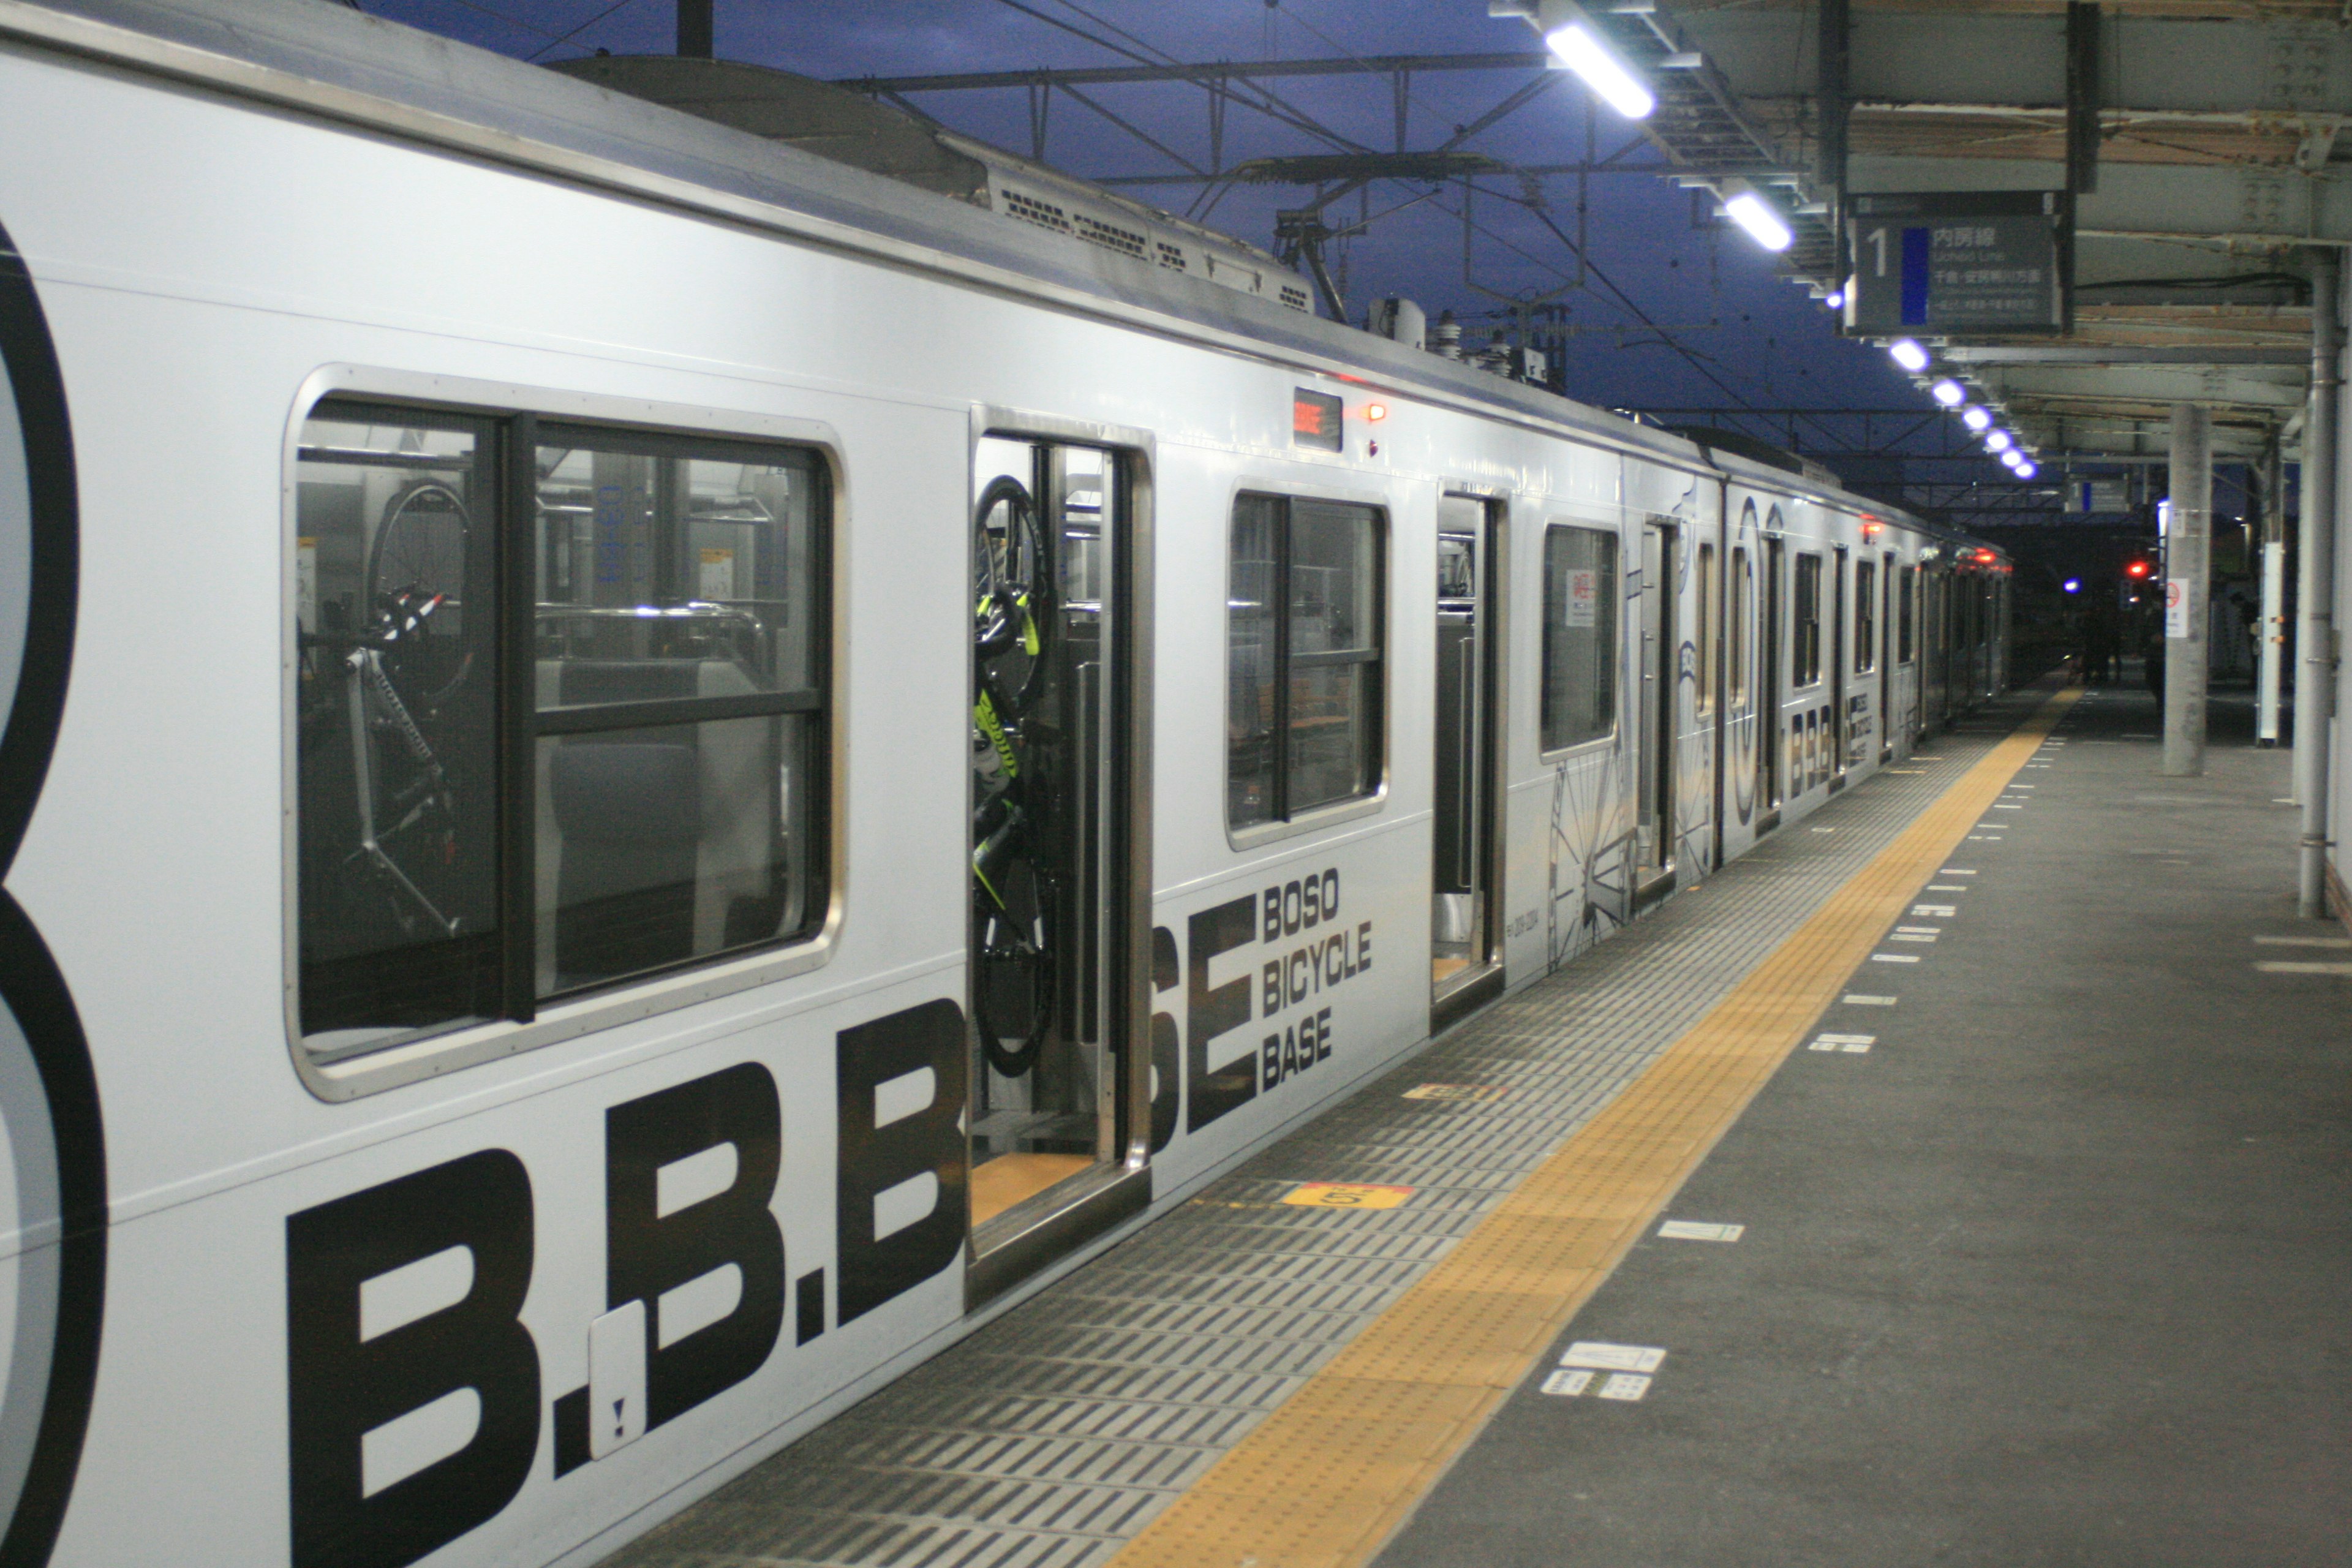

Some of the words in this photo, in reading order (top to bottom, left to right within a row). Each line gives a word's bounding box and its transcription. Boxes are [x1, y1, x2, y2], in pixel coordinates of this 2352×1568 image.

[1867, 228, 1886, 277] 1
[1933, 227, 1995, 247] 内房線
[1264, 867, 1339, 944] BOSO
[1263, 921, 1372, 1019] BICYCLE
[1263, 1006, 1332, 1093] BASE
